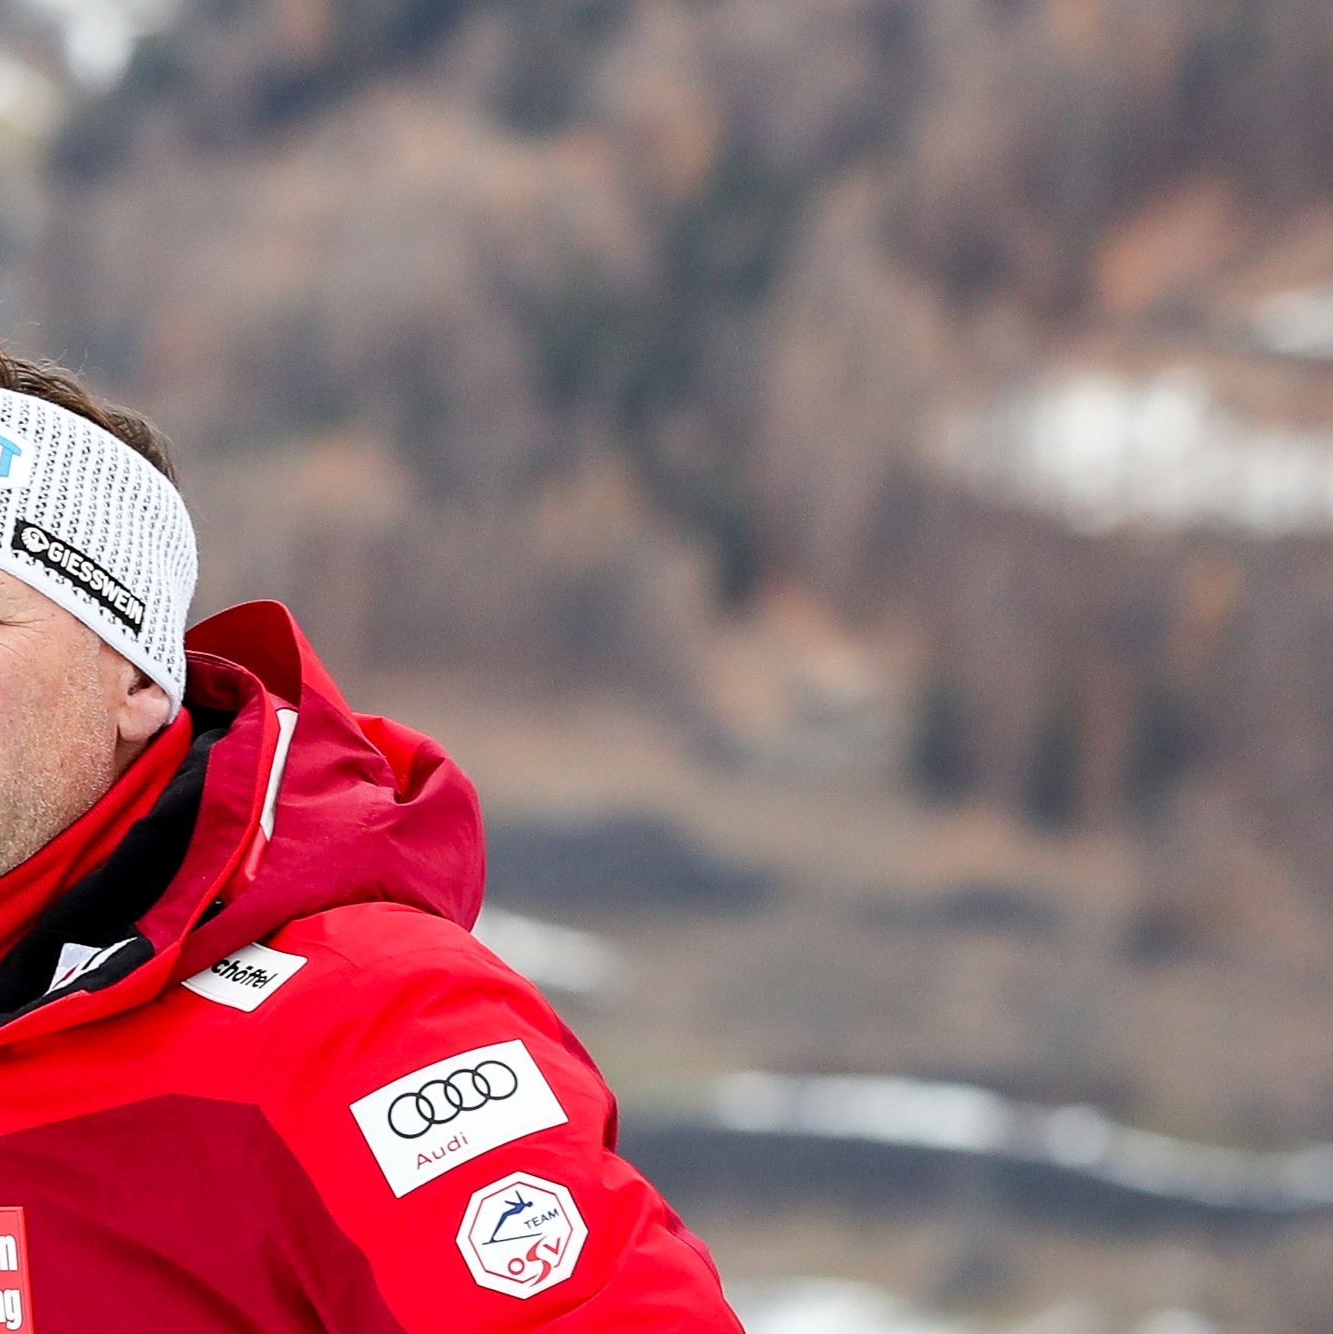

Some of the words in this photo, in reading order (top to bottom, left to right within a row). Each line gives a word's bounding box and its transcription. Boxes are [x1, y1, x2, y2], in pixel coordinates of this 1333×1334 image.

[47, 541, 144, 625] GIESSWEIN
[211, 959, 278, 989] chöffel
[416, 1132, 468, 1170] Audi
[524, 1208, 559, 1229] TEAM
